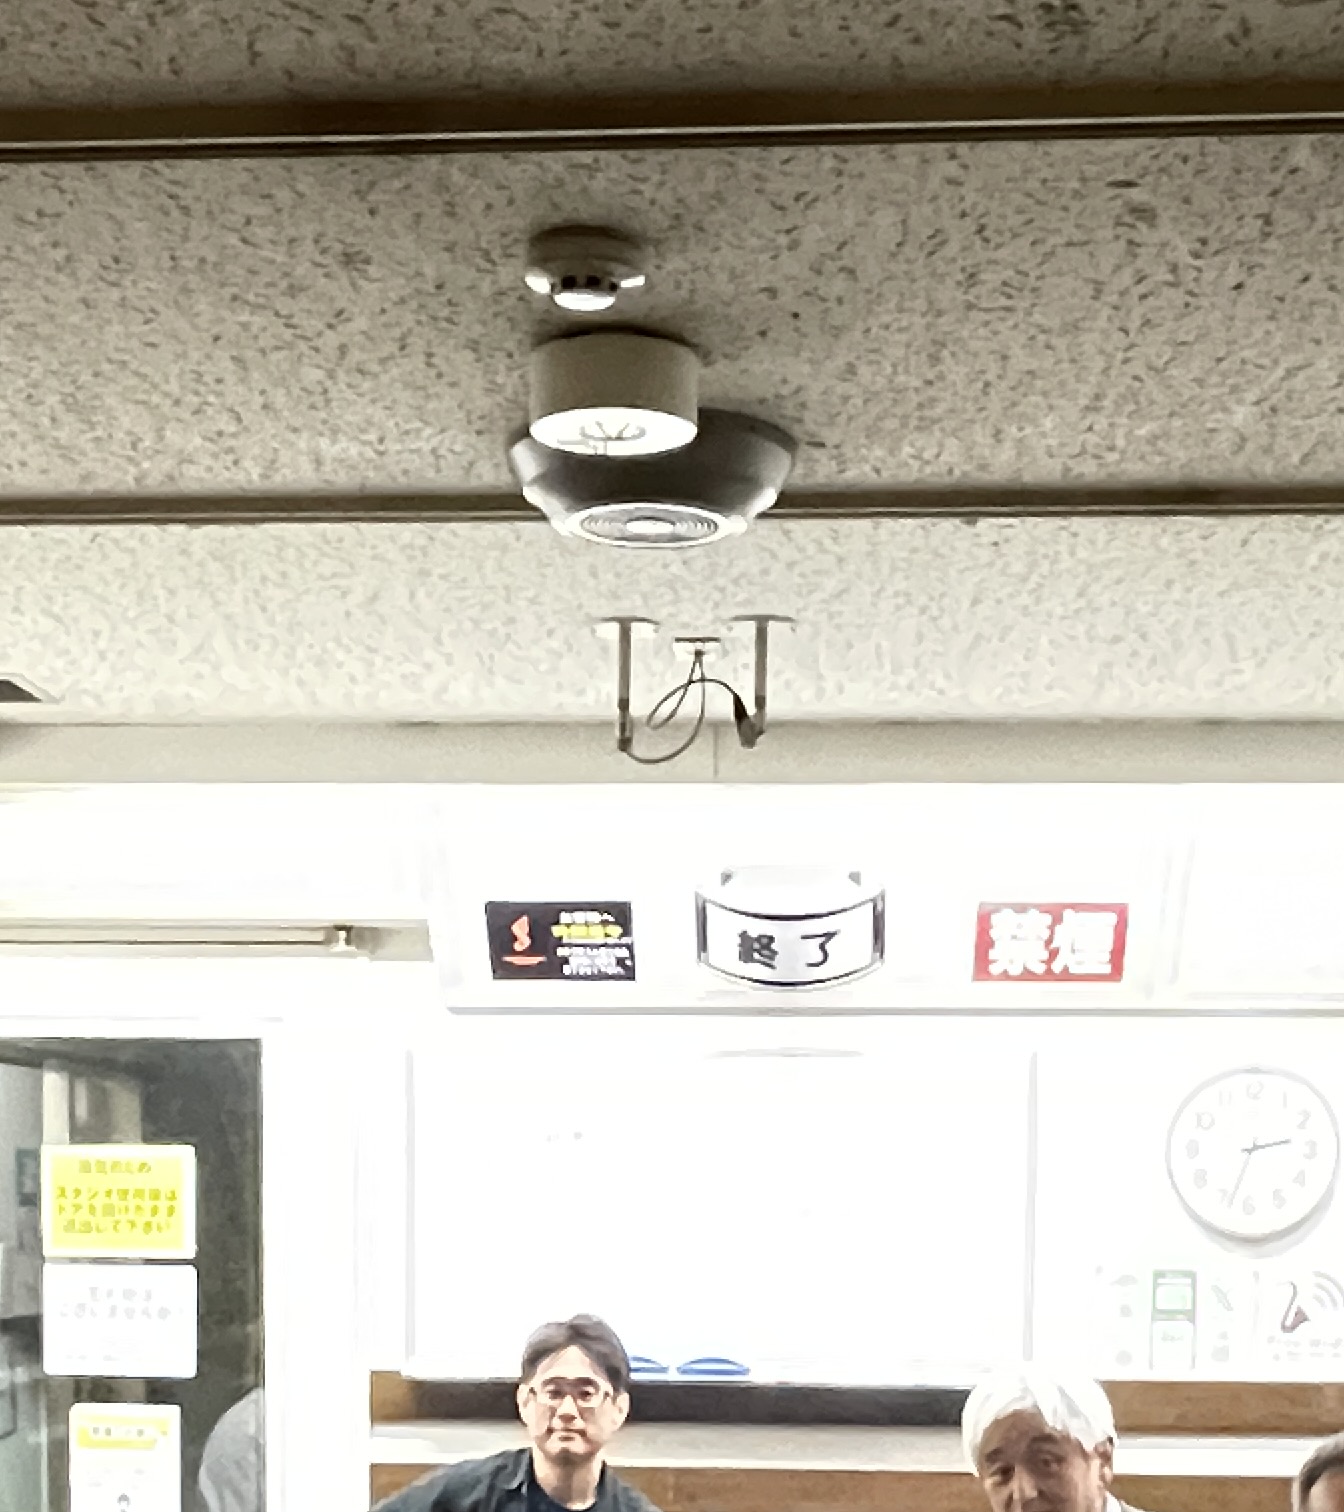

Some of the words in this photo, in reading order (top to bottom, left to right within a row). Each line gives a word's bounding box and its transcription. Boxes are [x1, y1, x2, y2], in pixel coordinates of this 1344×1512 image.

[737, 929, 841, 970] 終了
[988, 908, 1118, 975] 禁煙
[1296, 1108, 1312, 1130] 2
[1302, 1139, 1318, 1160] 3
[1291, 1168, 1306, 1188] 4
[1242, 1195, 1256, 1216] 6
